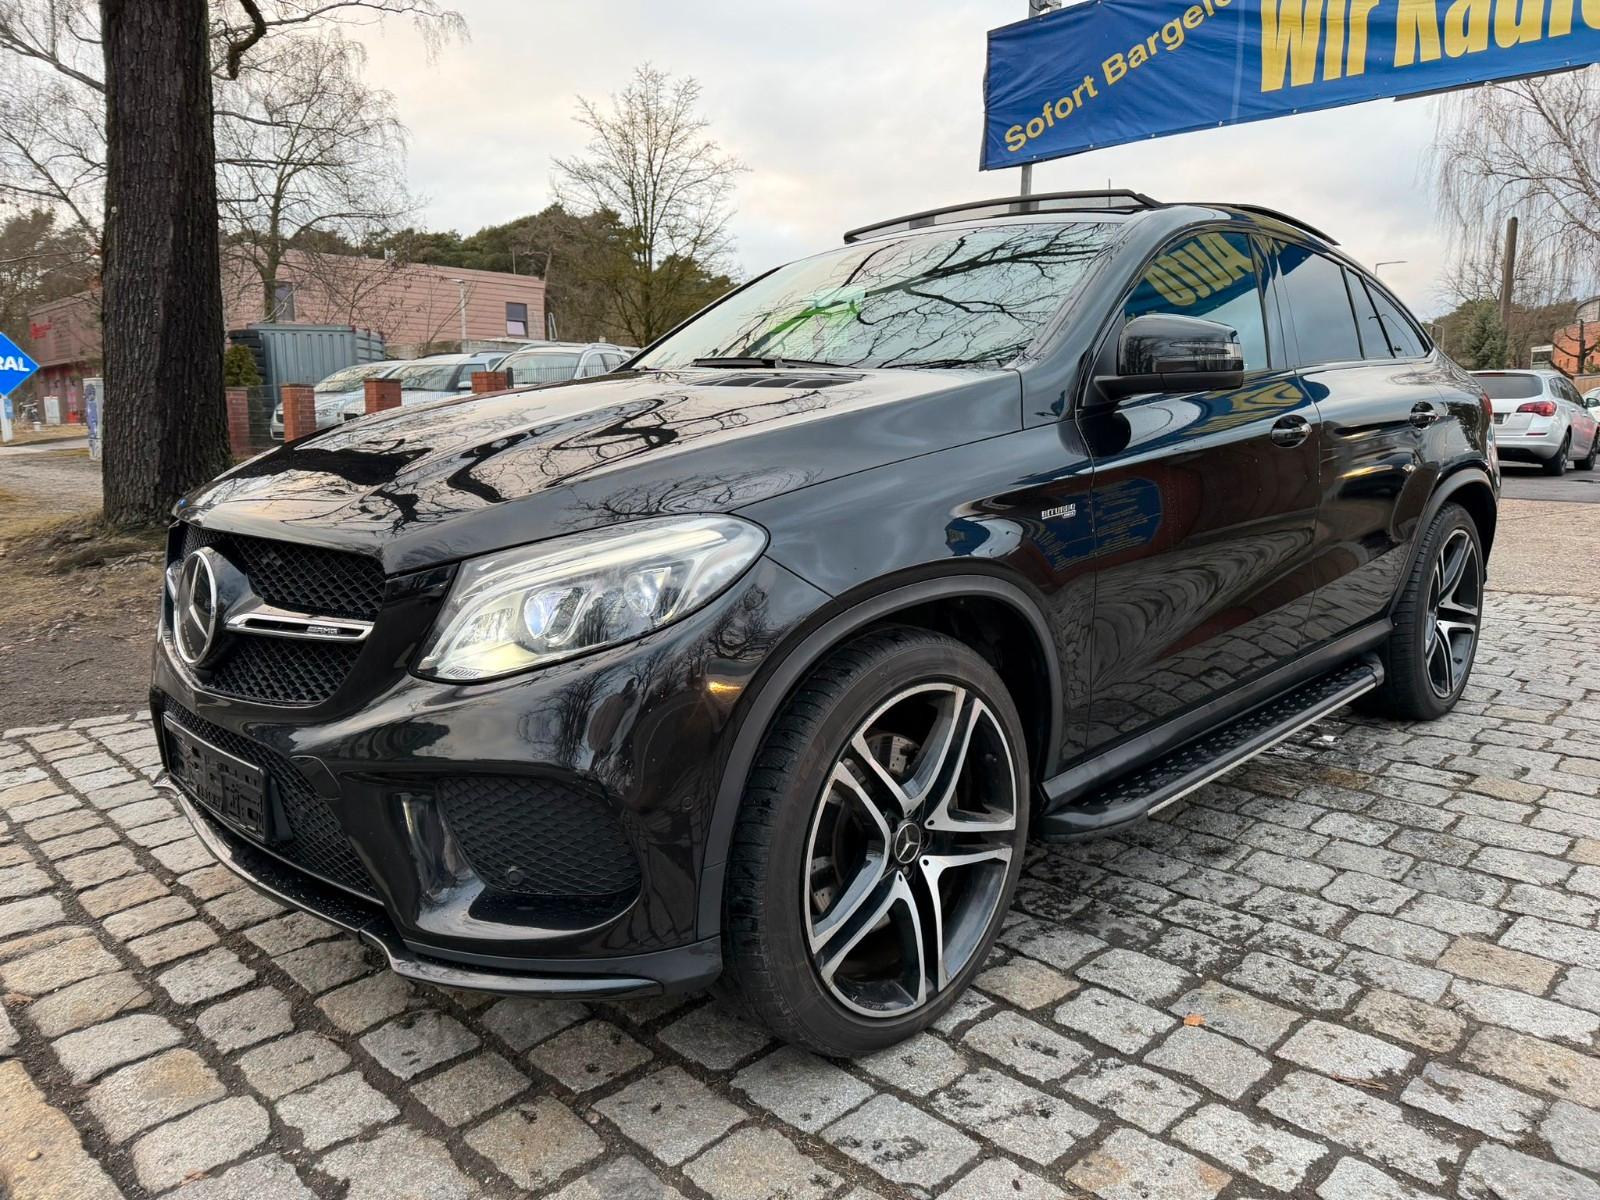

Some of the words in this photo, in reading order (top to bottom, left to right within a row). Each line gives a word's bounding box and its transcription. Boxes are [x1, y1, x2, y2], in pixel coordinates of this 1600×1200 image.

[1004, 75, 1098, 151] Sofort
[1101, 0, 1232, 85] Bargel
[1260, 0, 1379, 93] Wir
